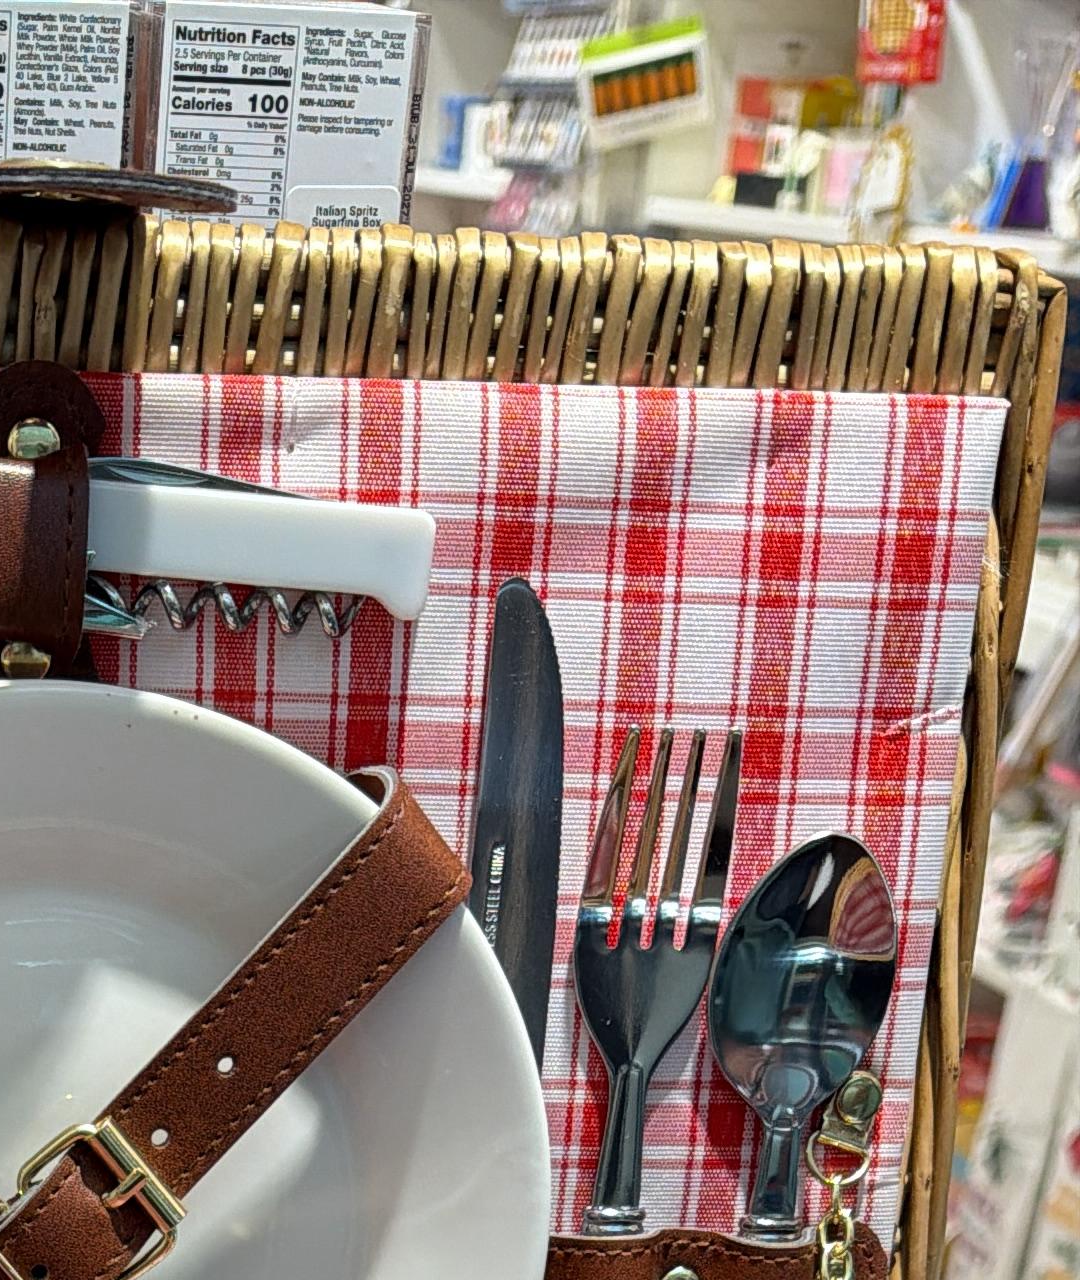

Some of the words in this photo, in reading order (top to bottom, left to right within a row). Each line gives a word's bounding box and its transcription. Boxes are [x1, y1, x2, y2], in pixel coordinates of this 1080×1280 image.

[175, 25, 247, 44] Nutrition
[252, 29, 296, 46] Facts
[175, 48, 188, 59] 2.5
[190, 48, 225, 61] Servings
[228, 50, 241, 61] Per
[243, 51, 282, 63] Container
[173, 61, 207, 73] Serving
[210, 62, 228, 73] size
[250, 66, 266, 76] pcs
[268, 65, 293, 78] (30g)
[171, 95, 232, 112] Calories
[248, 94, 289, 114] 100
[170, 130, 188, 139] Total
[190, 131, 202, 140] Fat
[316, 205, 346, 217] Italian
[349, 206, 379, 220] Spritz
[362, 217, 381, 227] Box
[490, 845, 505, 884] CHINA
[485, 885, 500, 922] STEEL
